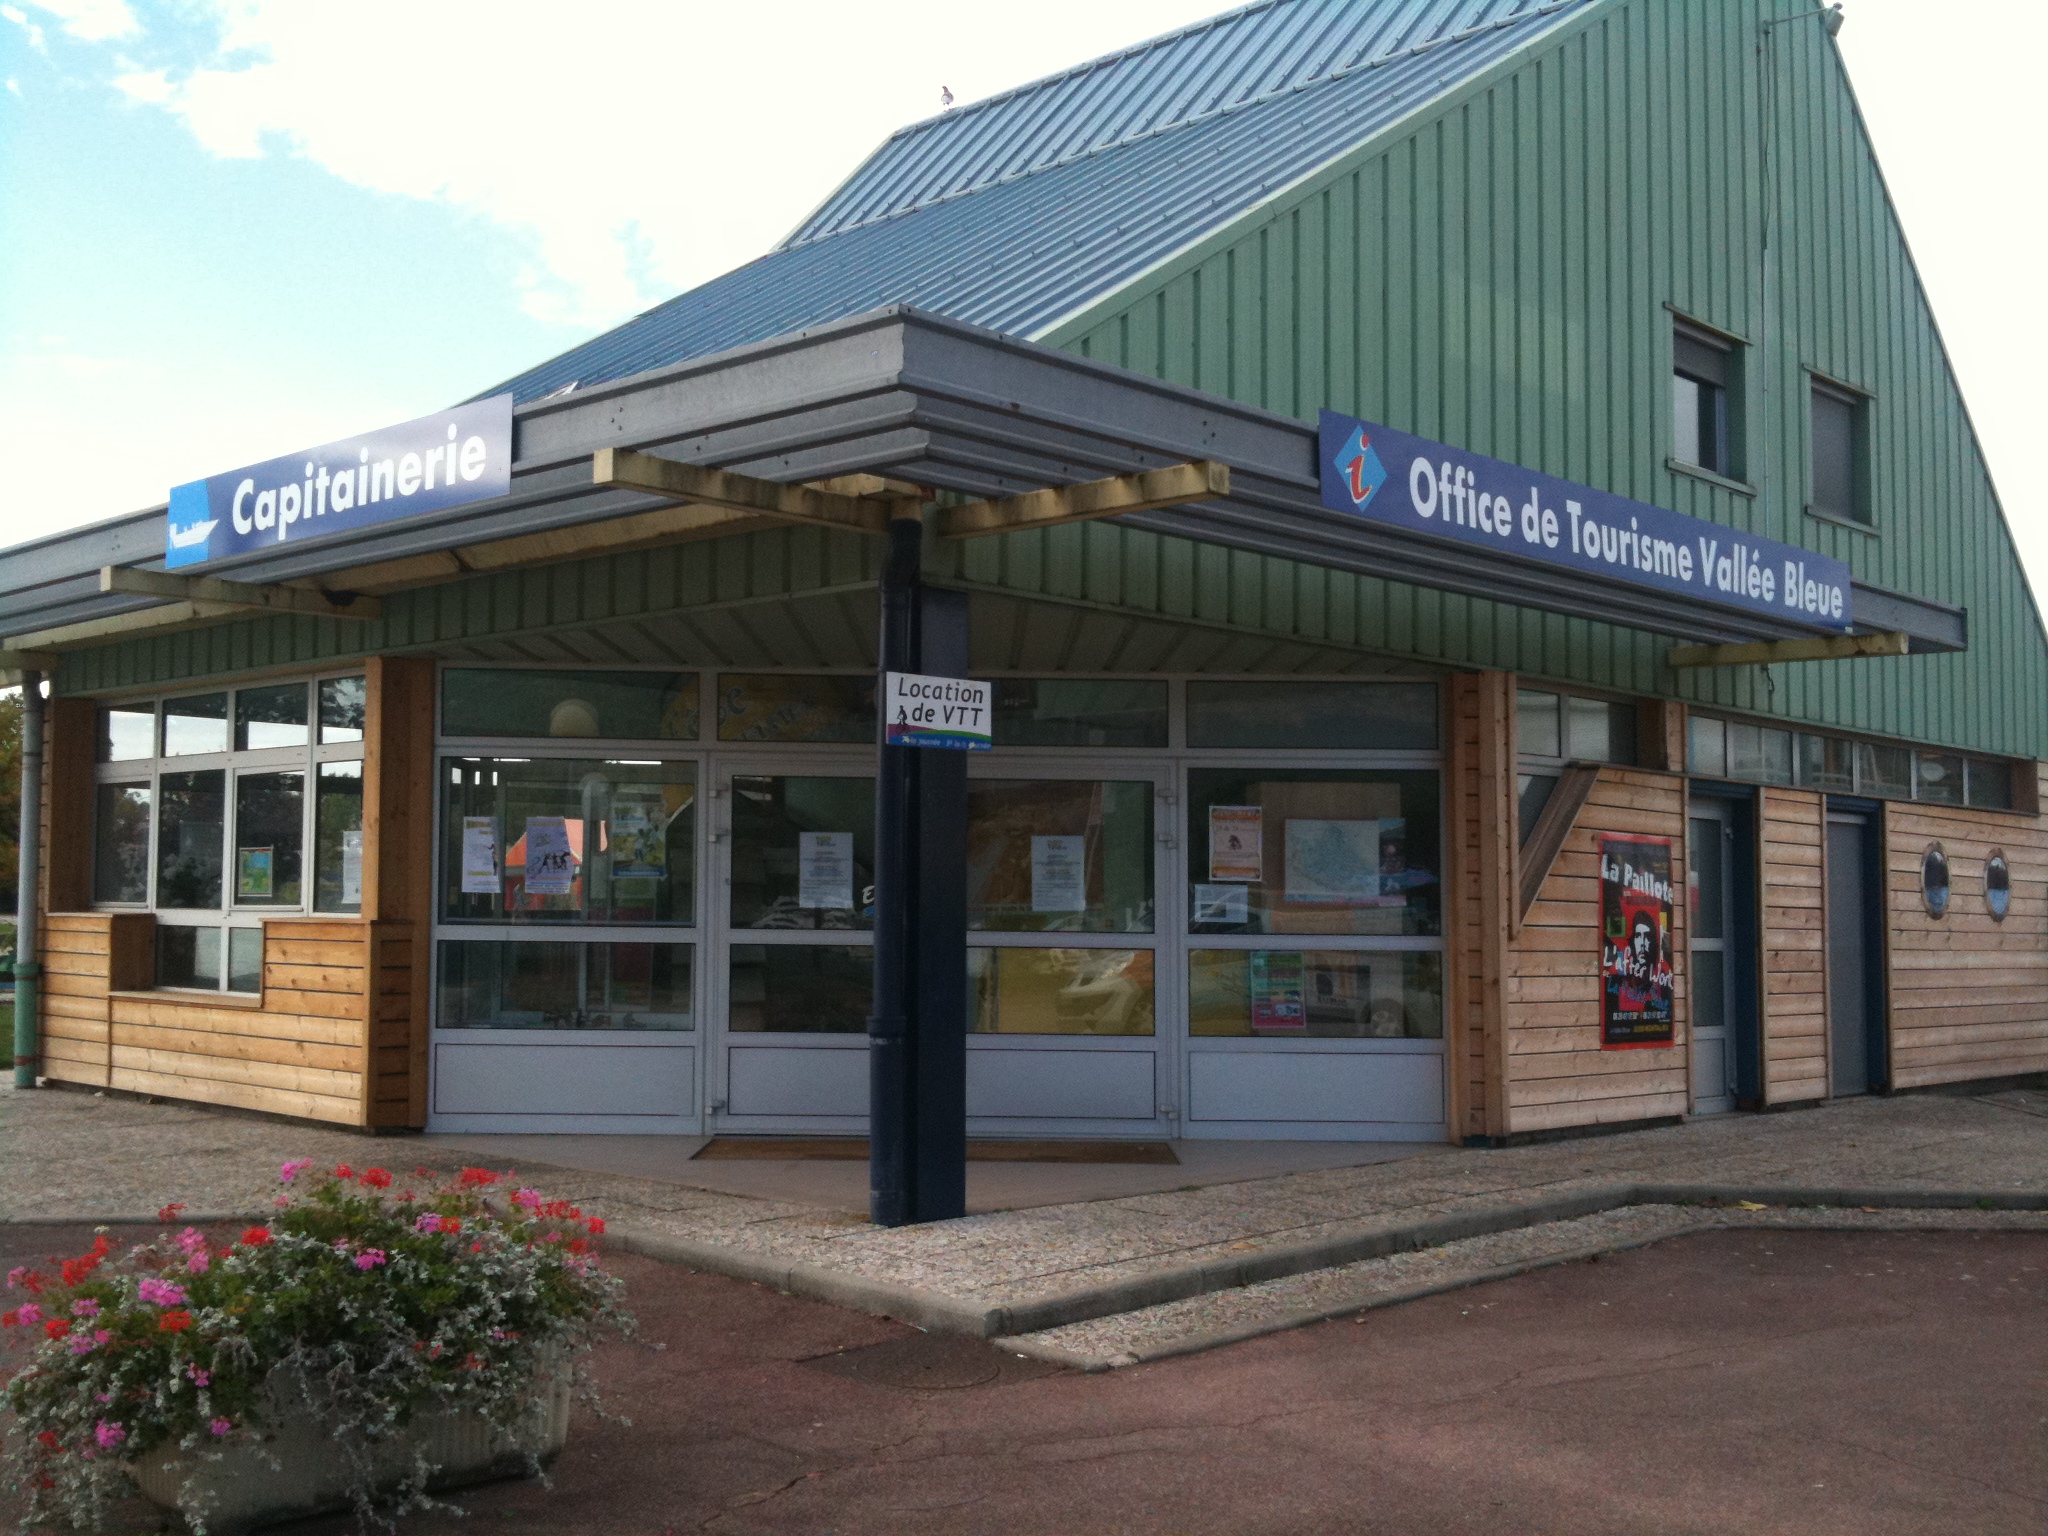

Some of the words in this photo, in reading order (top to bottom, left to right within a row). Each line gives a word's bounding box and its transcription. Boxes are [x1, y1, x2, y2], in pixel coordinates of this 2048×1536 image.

[232, 423, 487, 541] Capitainerie
[1409, 457, 1512, 537] Office
[1521, 486, 1559, 548] de
[1566, 499, 1693, 582] Tourisme
[1699, 536, 1775, 602] Vallée
[1785, 560, 1843, 619] Bleue
[898, 677, 984, 704] Location
[912, 702, 936, 723] de
[943, 705, 984, 727] VTT
[1601, 853, 1620, 883] La
